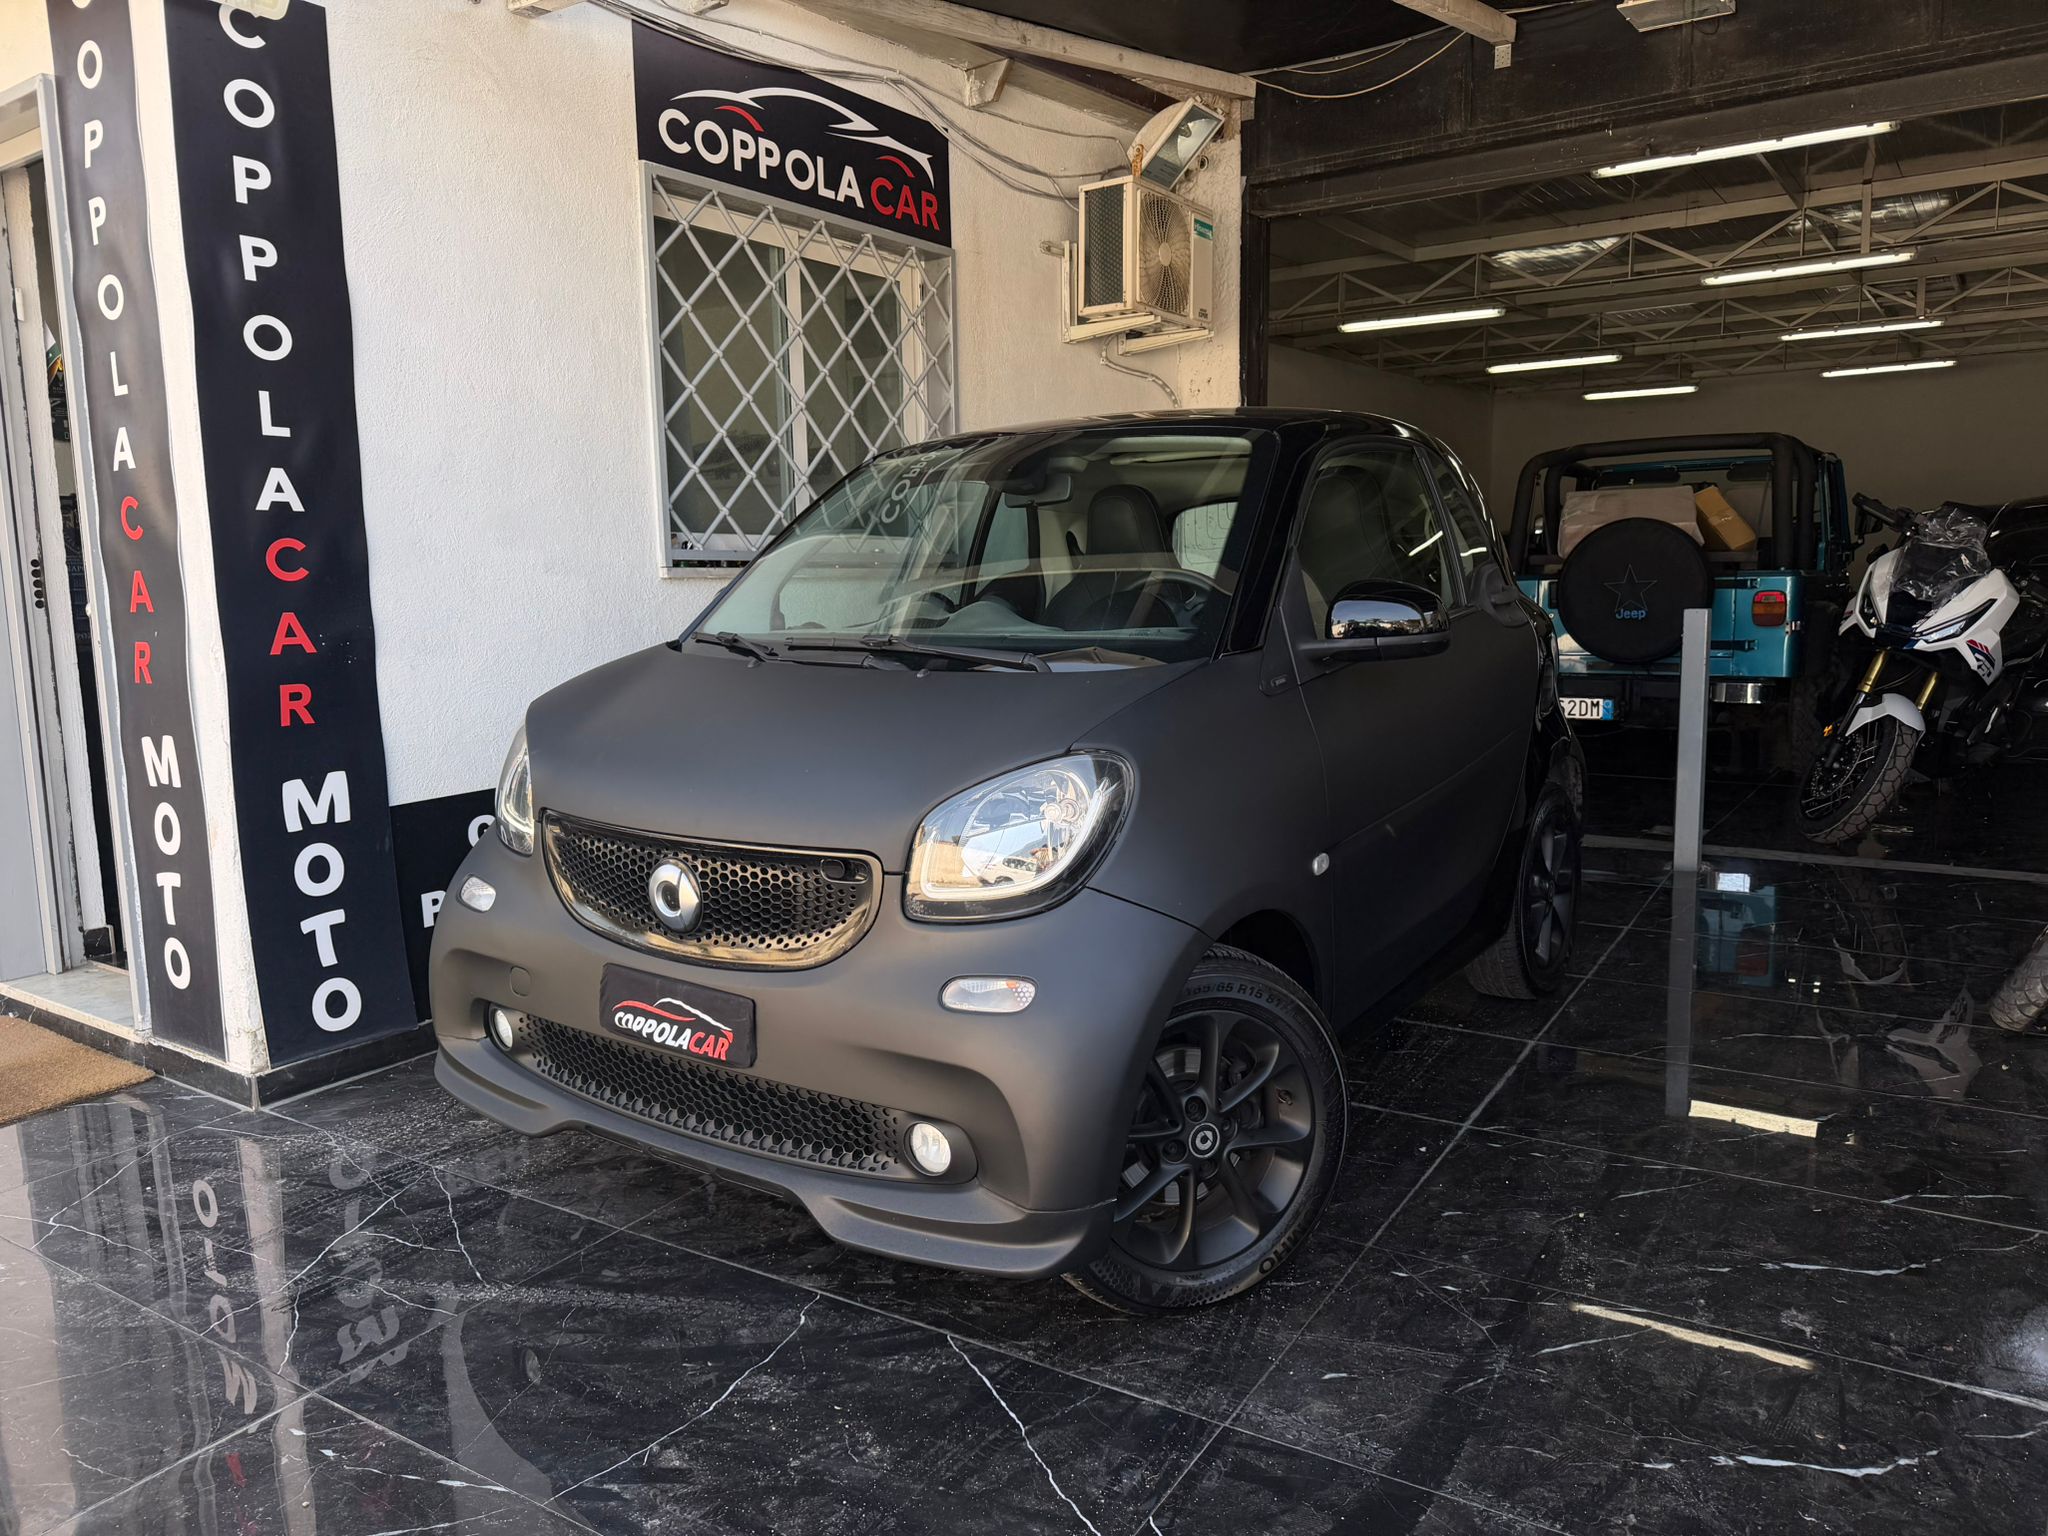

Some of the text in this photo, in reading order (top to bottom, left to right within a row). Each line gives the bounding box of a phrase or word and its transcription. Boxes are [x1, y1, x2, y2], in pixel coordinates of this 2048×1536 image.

[71, 0, 136, 471] OPPOLA
[140, 734, 191, 990] MOTO
[1615, 608, 1647, 620] Jeep
[282, 770, 362, 1032] MOTO
